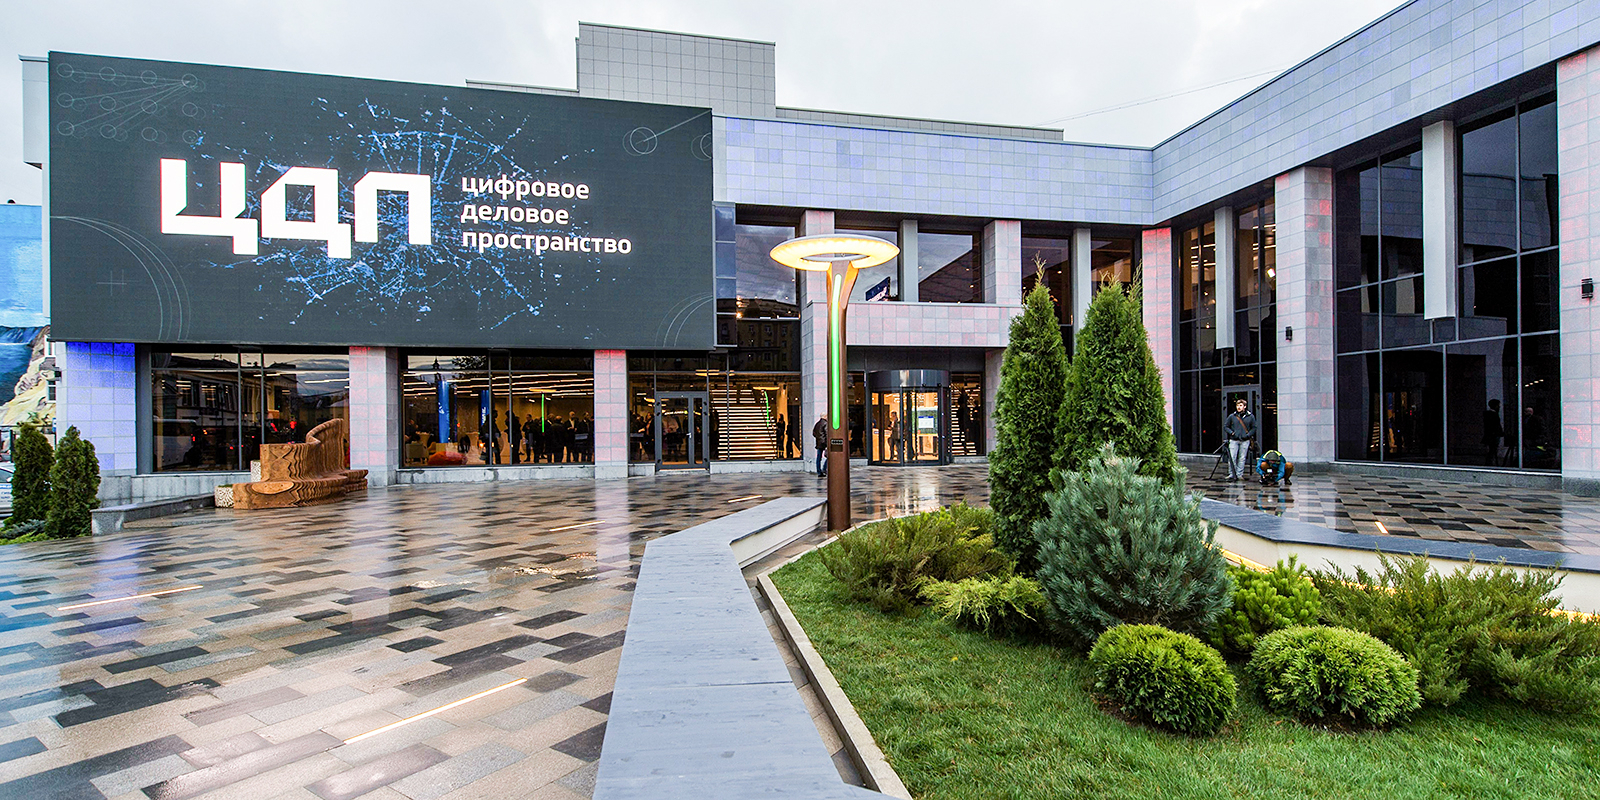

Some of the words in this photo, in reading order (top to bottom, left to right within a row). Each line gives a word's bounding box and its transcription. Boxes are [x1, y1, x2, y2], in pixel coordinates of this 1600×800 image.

[461, 174, 590, 200] цифровое
[160, 158, 432, 259] ЦДП
[460, 204, 570, 225] деловое
[462, 231, 632, 255] пространство
